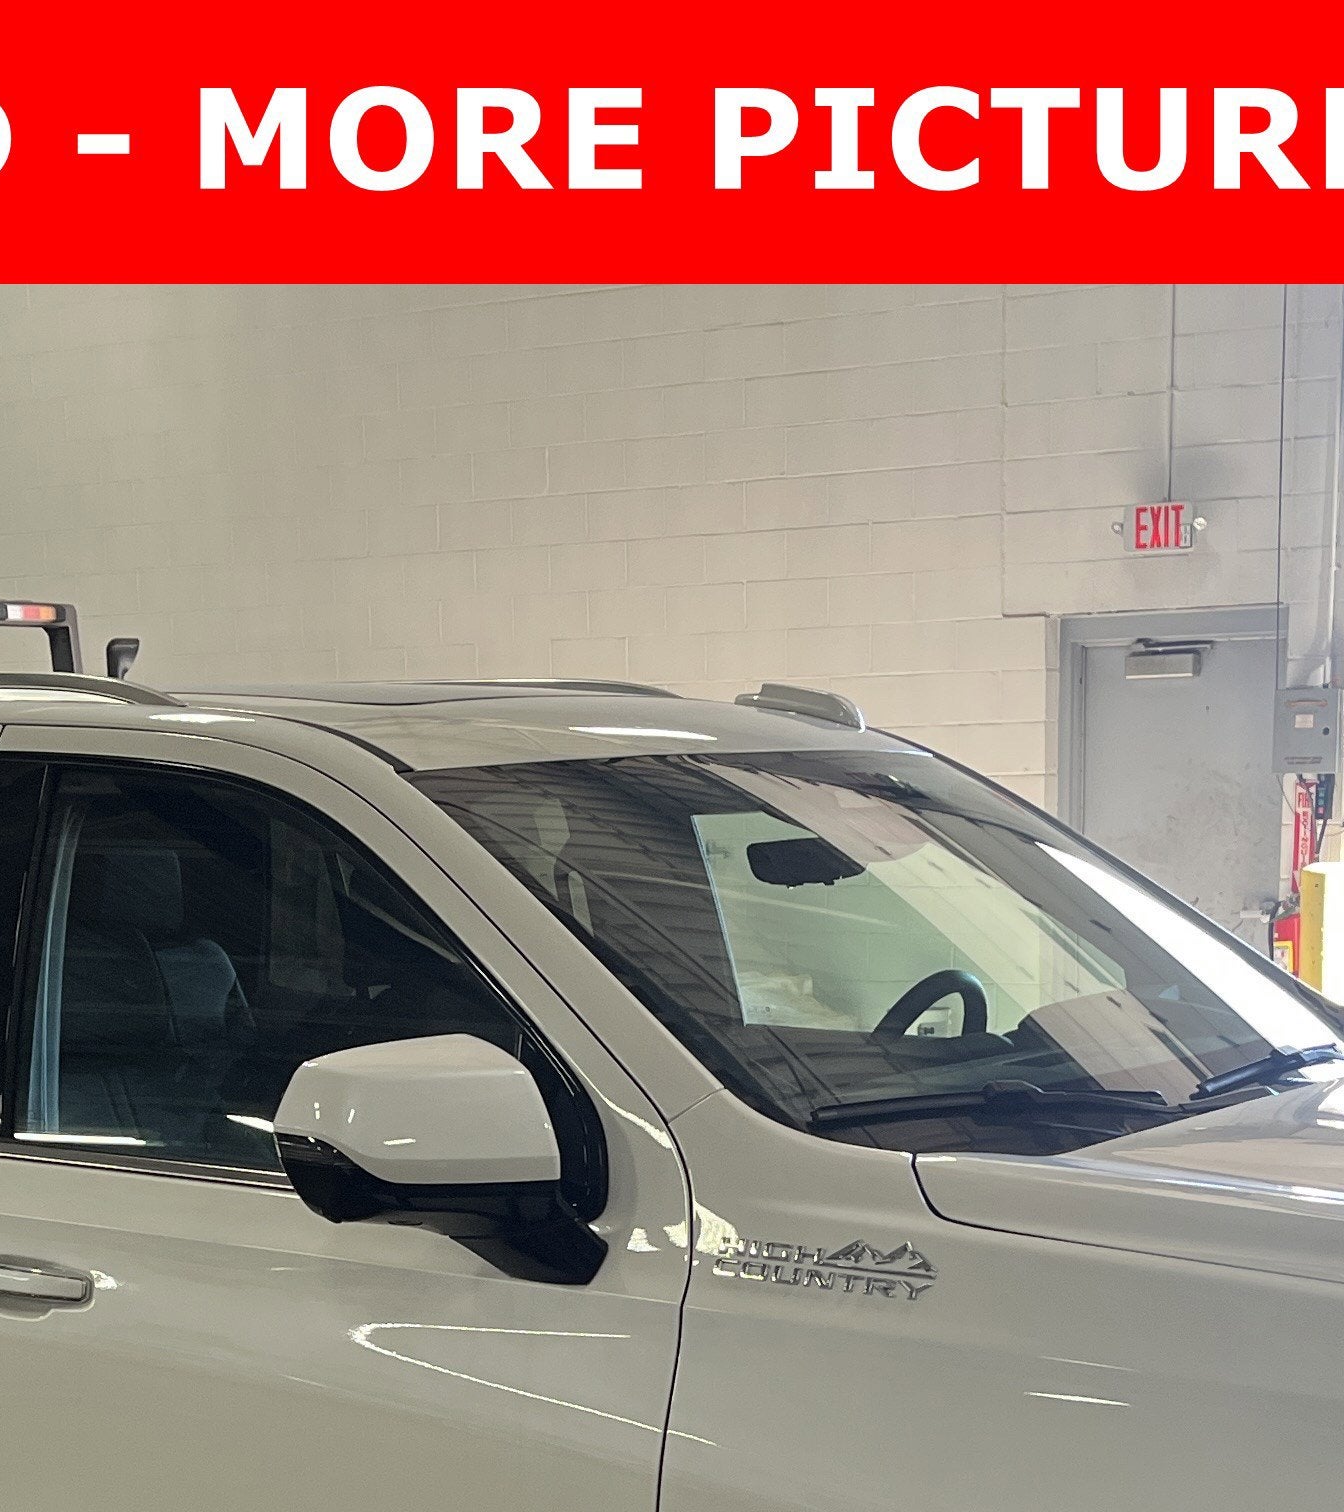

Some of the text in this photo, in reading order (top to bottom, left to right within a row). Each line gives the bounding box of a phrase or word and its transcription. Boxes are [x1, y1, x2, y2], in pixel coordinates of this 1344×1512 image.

[1134, 503, 1185, 549] EXIT
[717, 1236, 827, 1266] HIGH
[712, 1257, 936, 1301] COUNTRY
